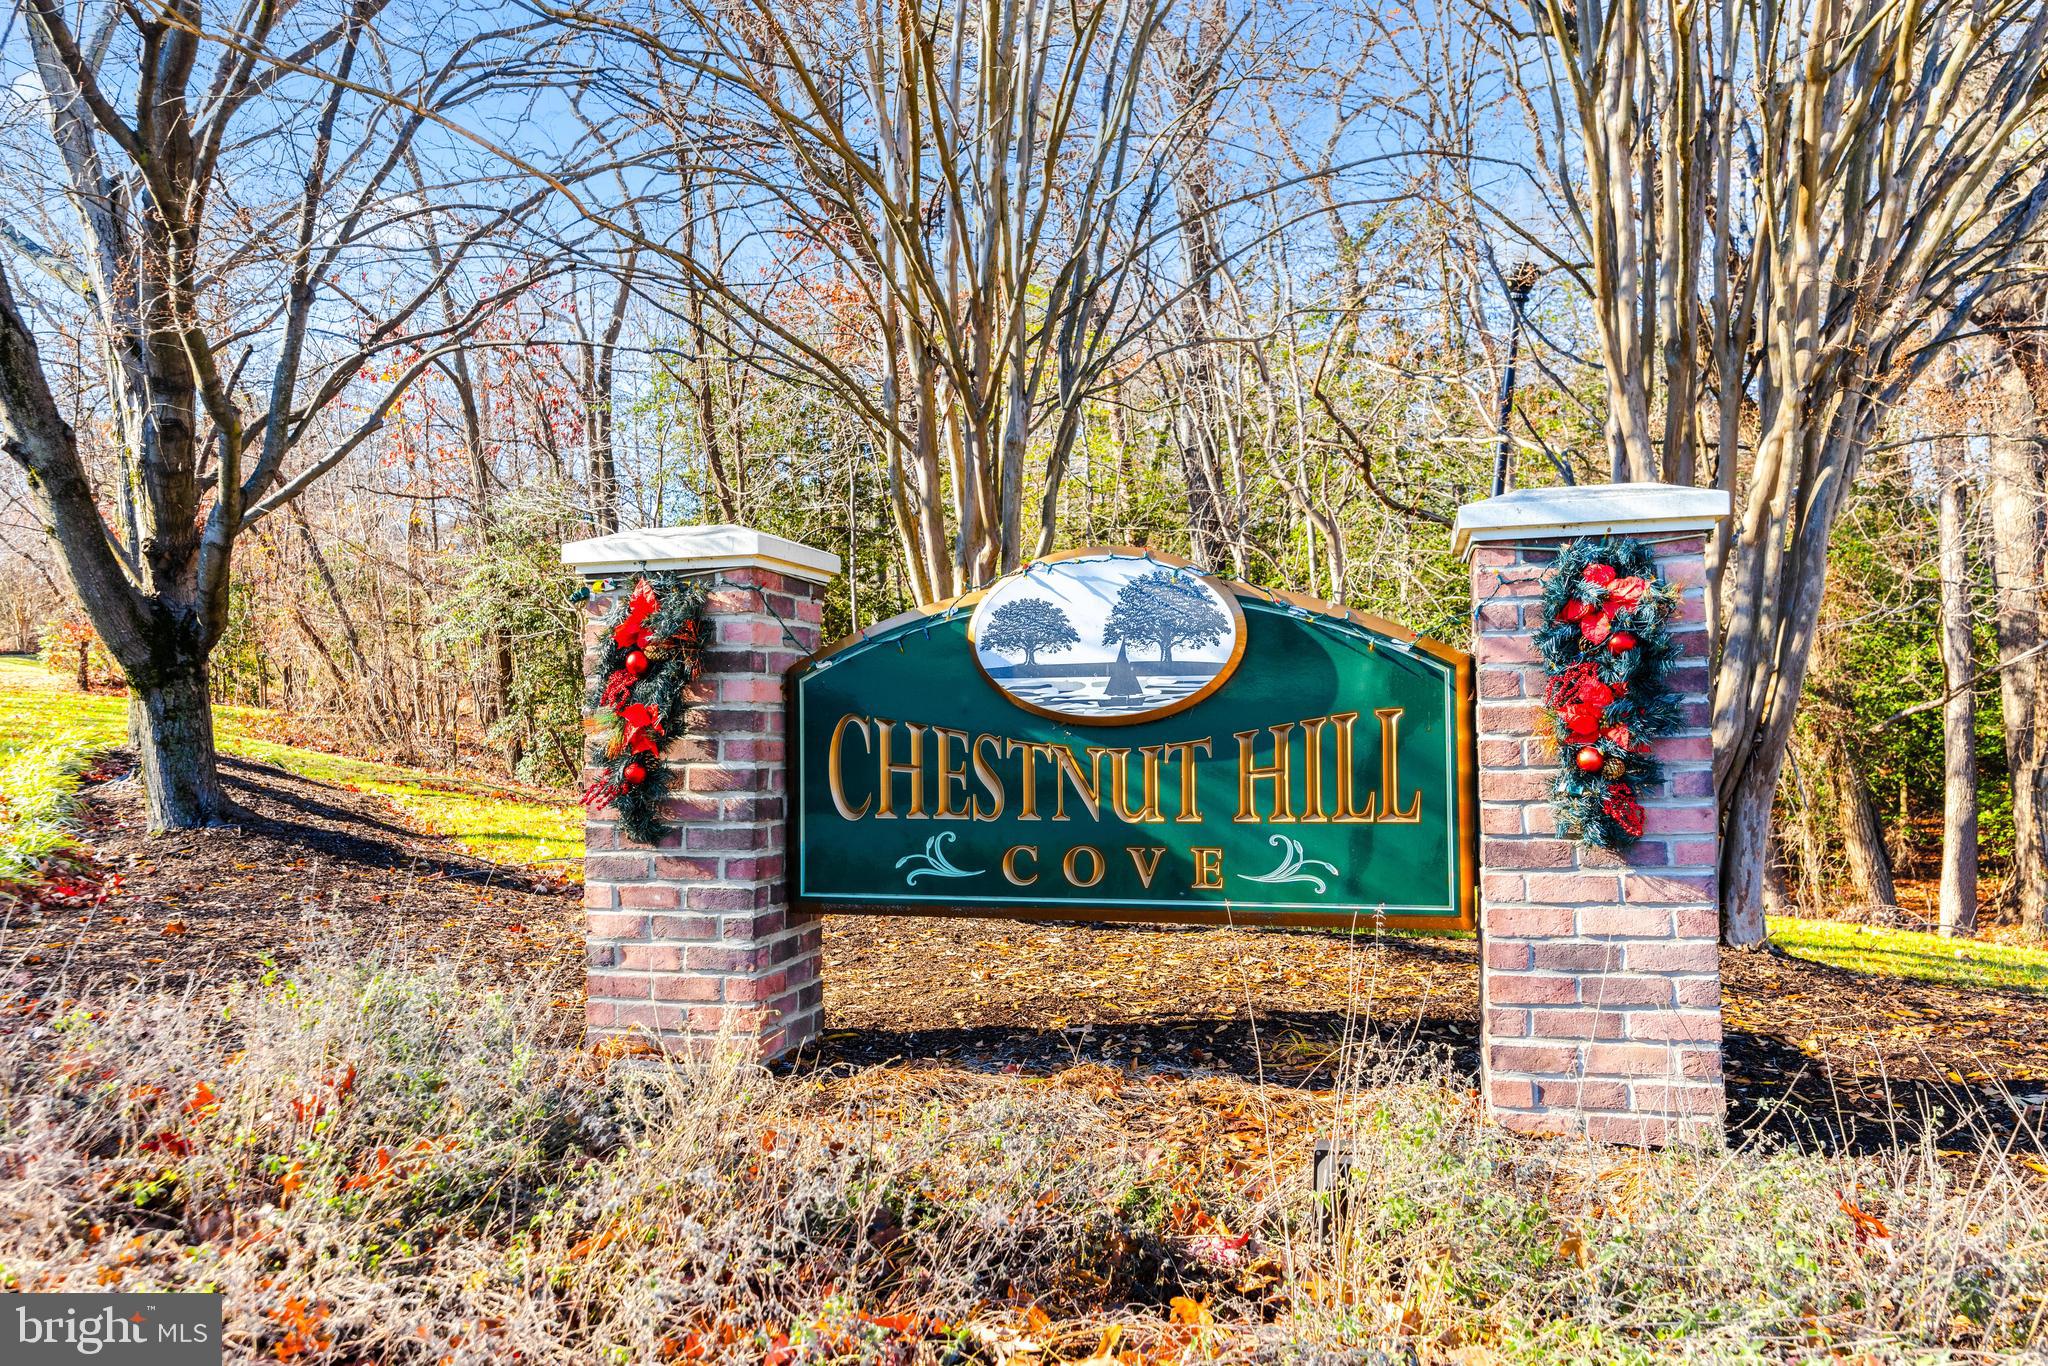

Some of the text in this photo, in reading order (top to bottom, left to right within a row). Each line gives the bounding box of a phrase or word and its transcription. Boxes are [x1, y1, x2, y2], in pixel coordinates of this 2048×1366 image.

[828, 708, 1421, 823] CHESTNUT HILL
[1002, 845, 1224, 889] COVE
